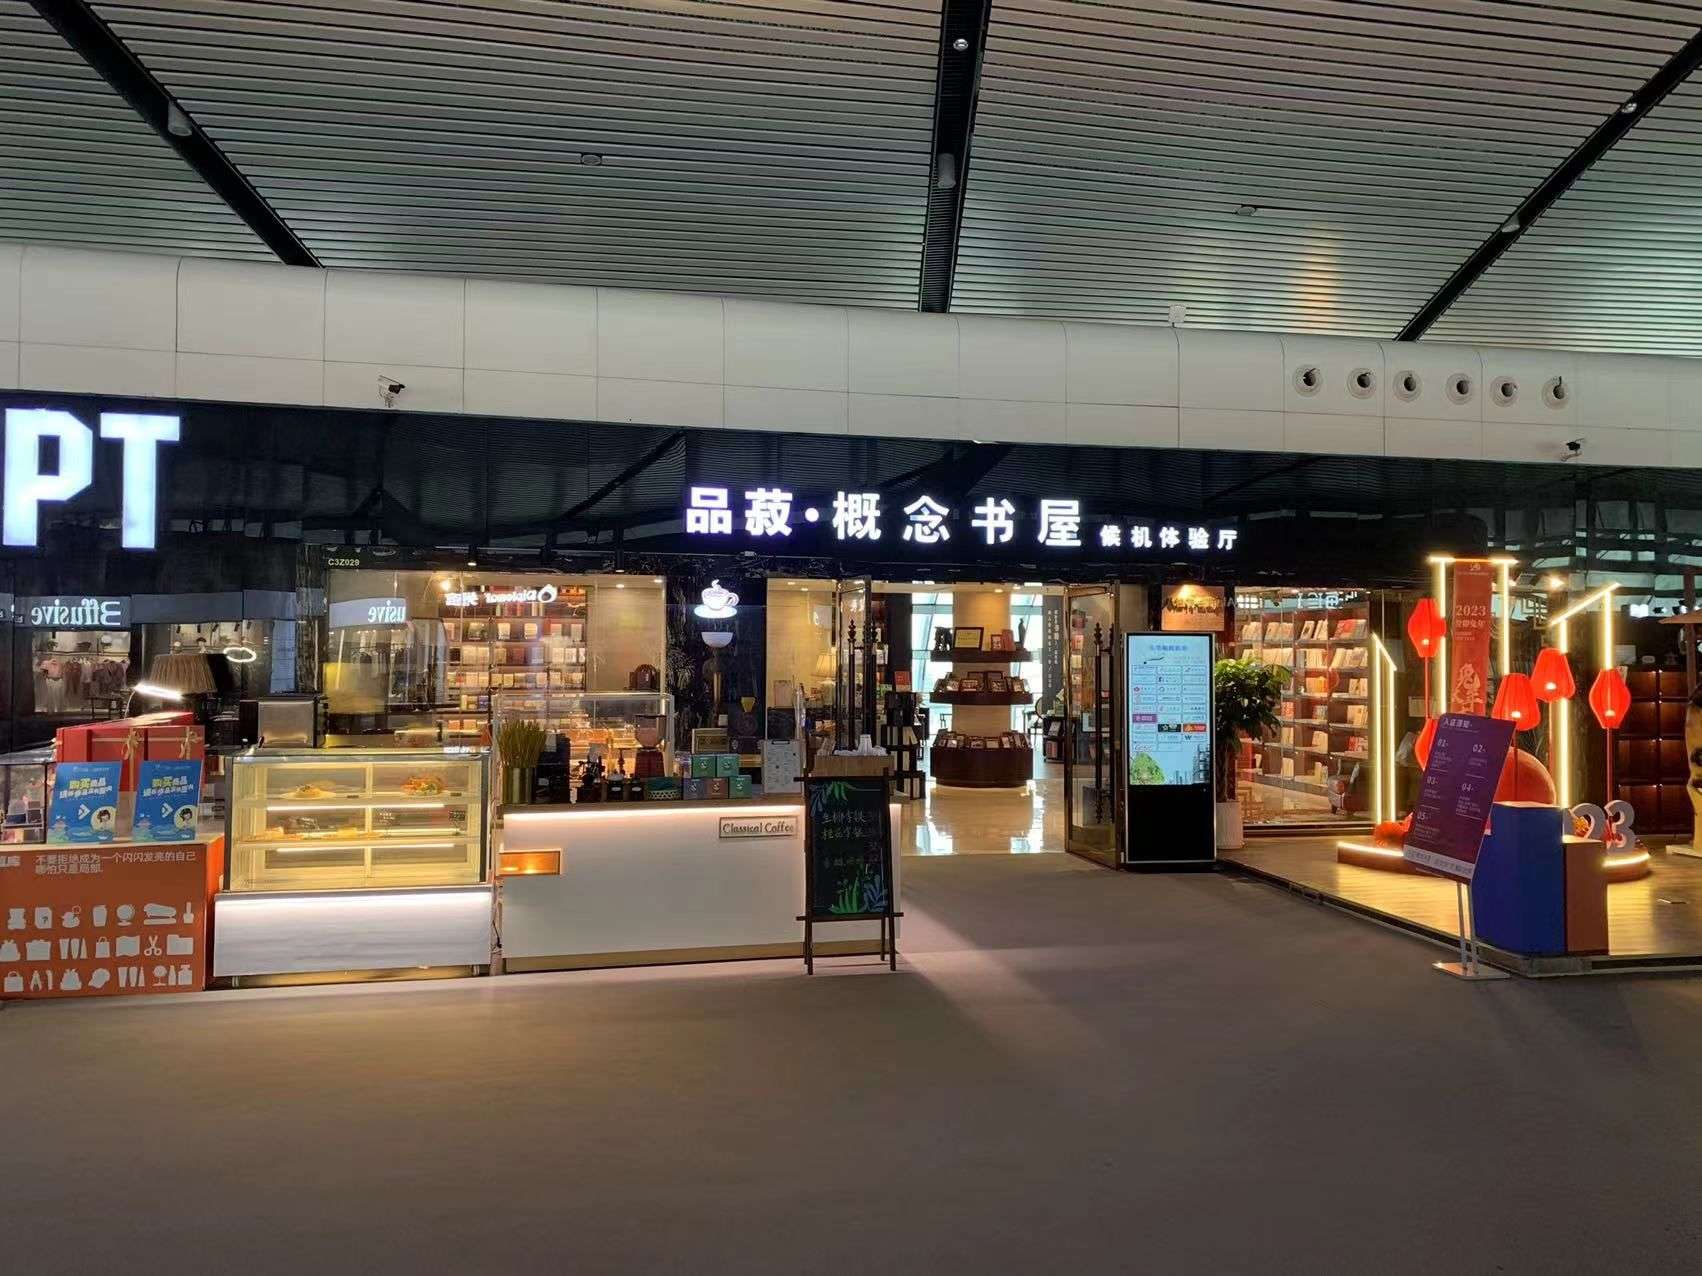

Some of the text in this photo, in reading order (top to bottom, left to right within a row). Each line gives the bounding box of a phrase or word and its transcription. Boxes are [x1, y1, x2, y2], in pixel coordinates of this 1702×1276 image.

[3, 407, 180, 550] PT
[1455, 605, 1486, 617] 2023
[722, 820, 795, 834] Classical Coffee
[1563, 800, 1637, 853] 23
